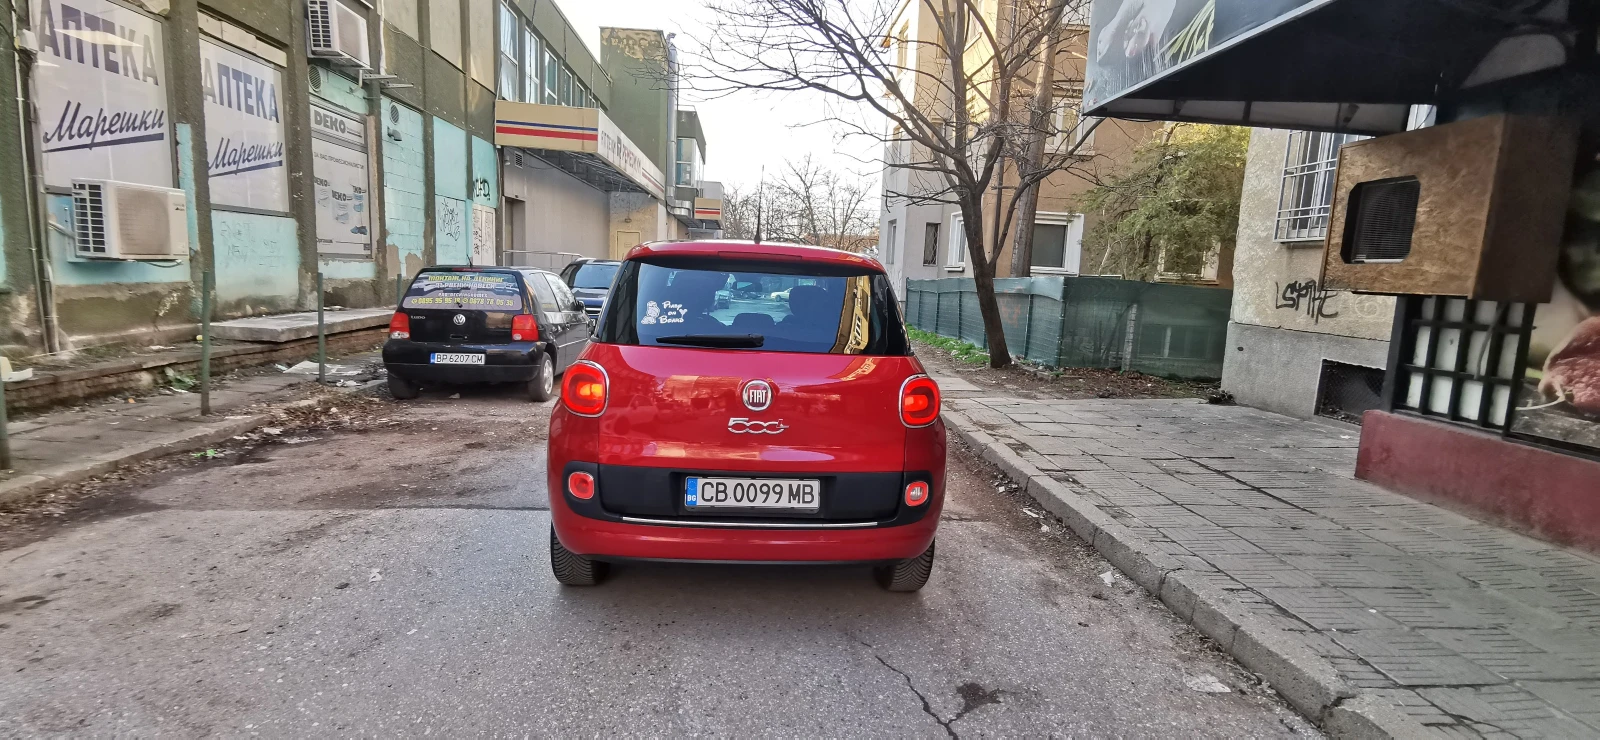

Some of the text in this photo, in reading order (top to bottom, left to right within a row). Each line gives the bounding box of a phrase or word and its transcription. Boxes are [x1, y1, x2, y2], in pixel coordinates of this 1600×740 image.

[39, 0, 159, 86] АПТЕКА
[203, 57, 280, 123] АПТЕКА
[43, 100, 164, 149] Марешки
[314, 110, 346, 134] DEKO
[208, 137, 283, 174] Марешки
[449, 354, 470, 363] 6207
[749, 389, 767, 403] FIAT
[687, 494, 697, 502] BG
[701, 481, 815, 504] CB 0099 MB
